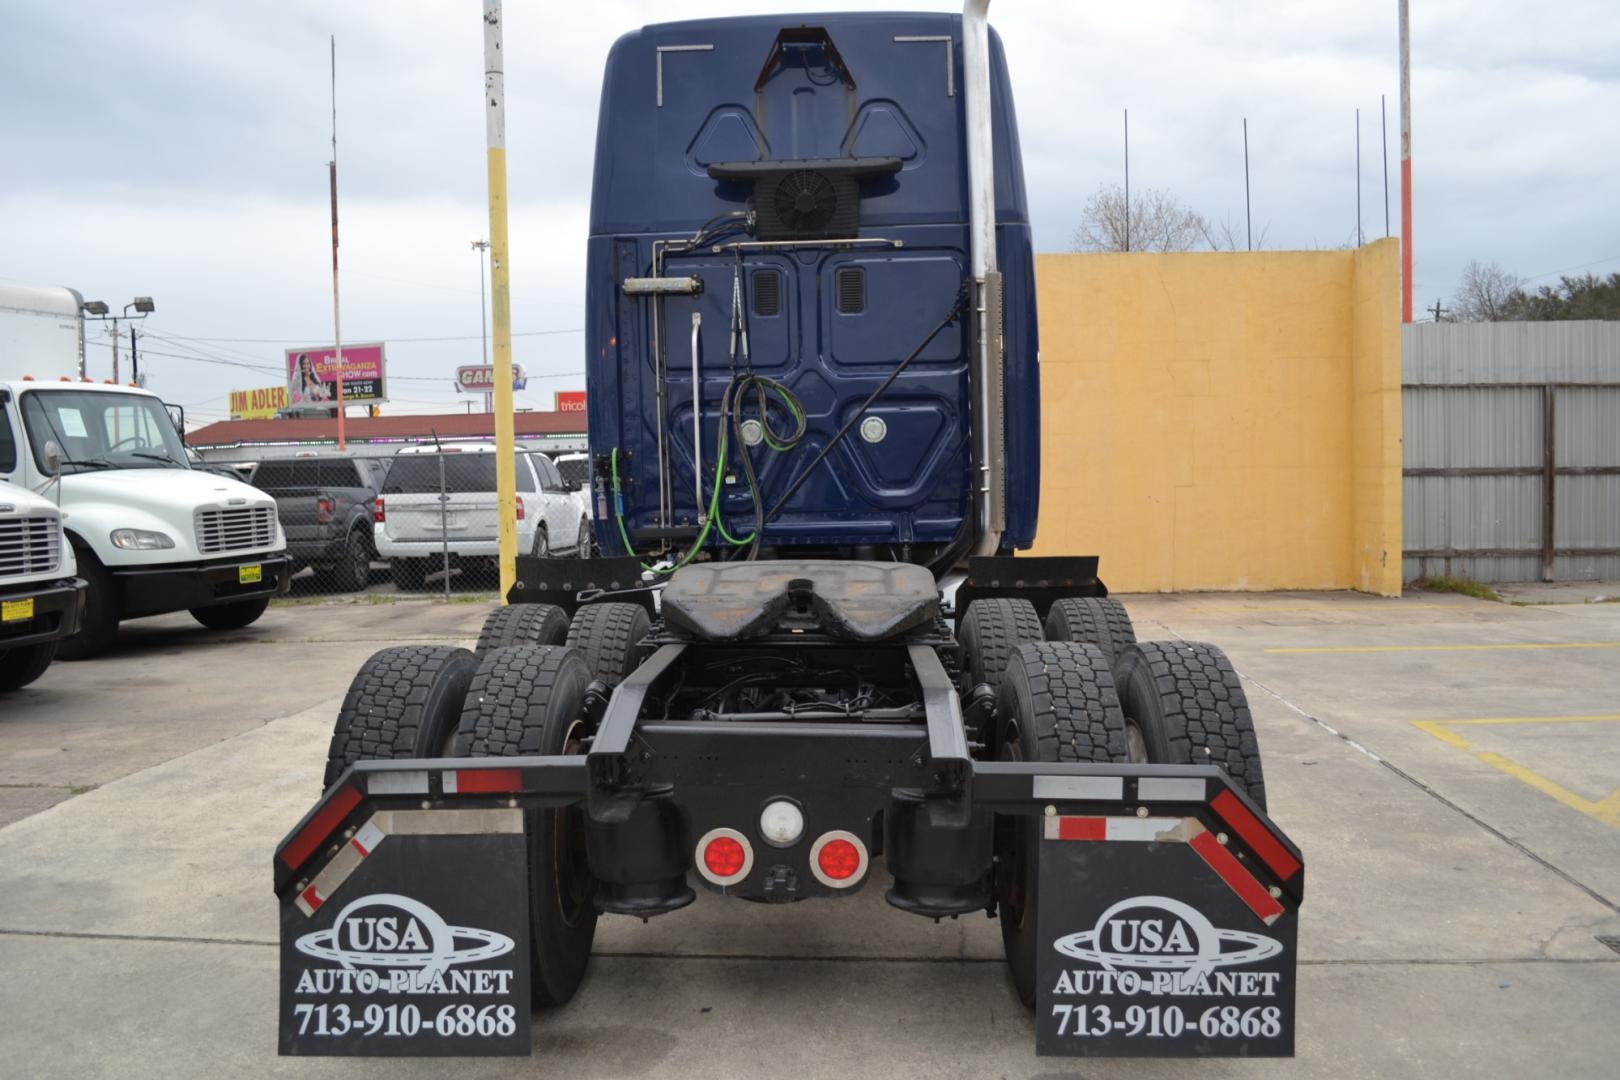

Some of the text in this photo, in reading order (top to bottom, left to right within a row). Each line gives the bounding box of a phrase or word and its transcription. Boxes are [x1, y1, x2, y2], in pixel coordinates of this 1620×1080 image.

[315, 361, 377, 373] EXTRVAGANZA
[323, 355, 349, 365] BRIAL
[340, 369, 378, 379] HOW.com
[461, 369, 519, 384] GAS
[231, 387, 285, 412] JIM ADLER
[346, 917, 429, 951] USA
[1108, 919, 1194, 953] USA
[295, 968, 513, 994] AUTO PLANET
[1052, 969, 1280, 996] AUTO PLANET
[294, 1003, 516, 1036] 713-910-6868
[1052, 1004, 1281, 1037] 713-910-6868
